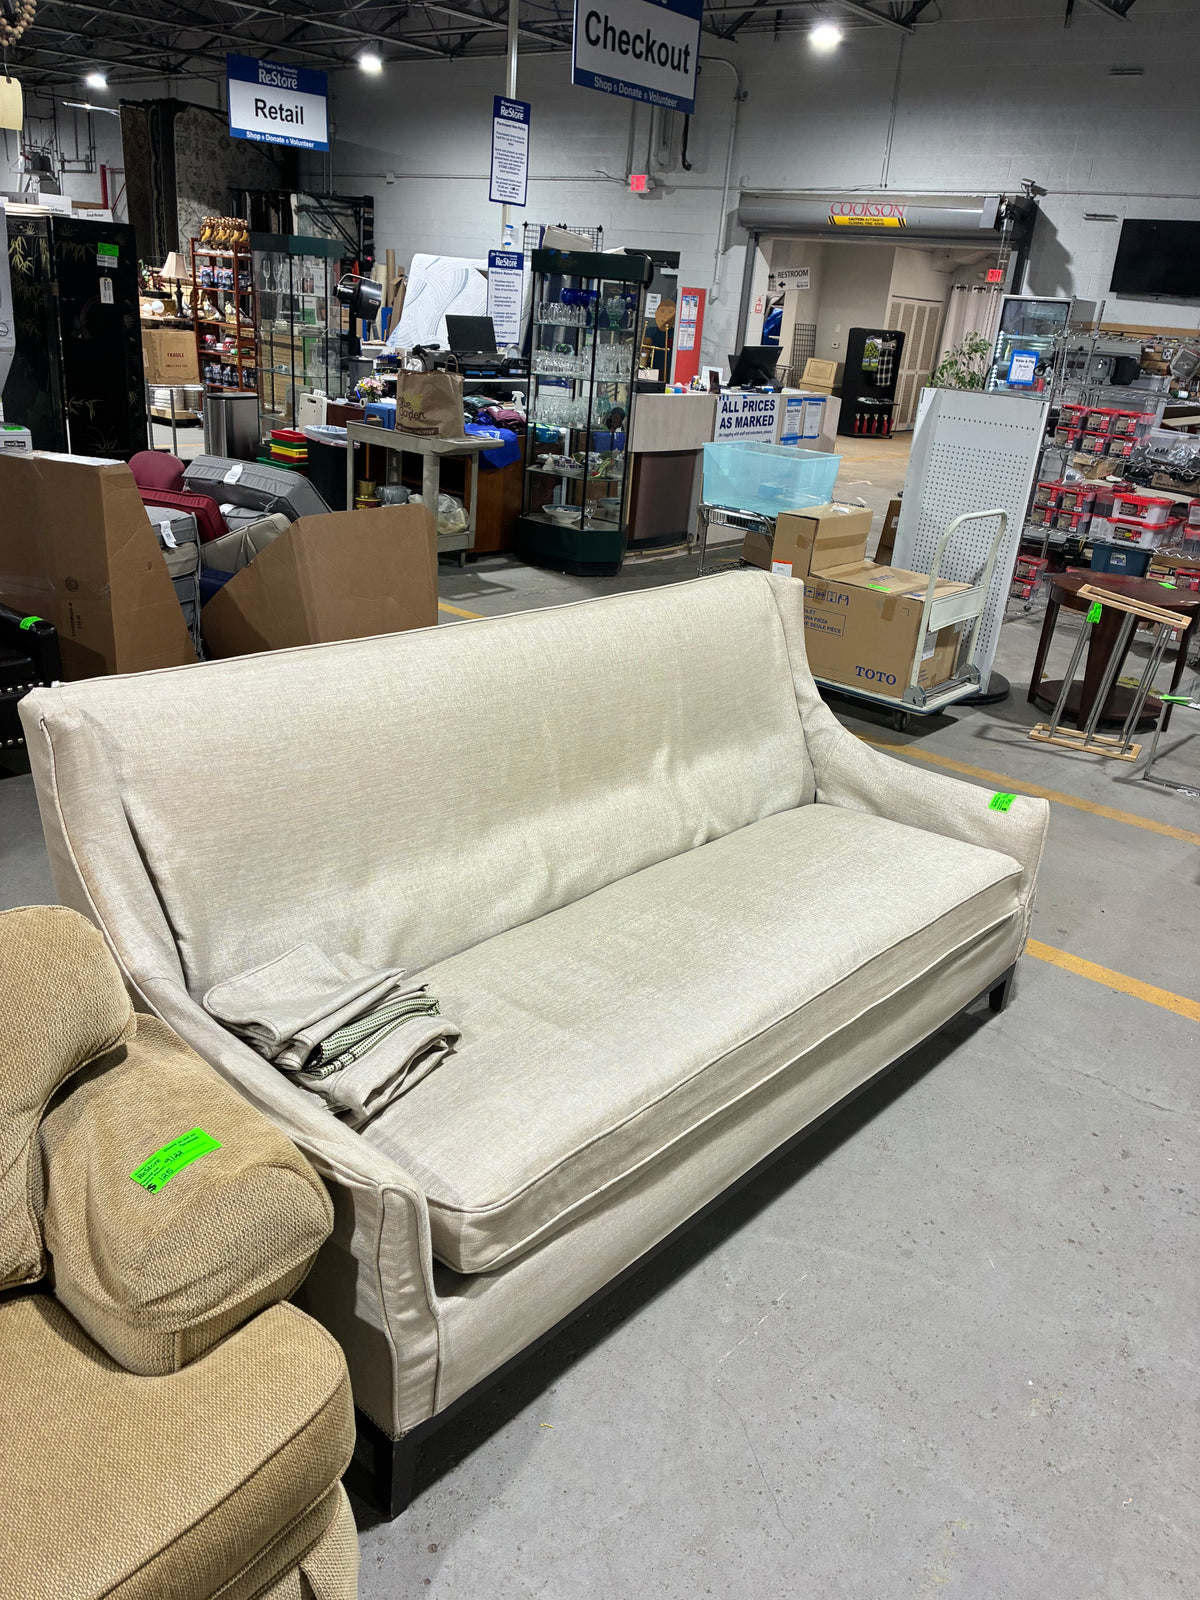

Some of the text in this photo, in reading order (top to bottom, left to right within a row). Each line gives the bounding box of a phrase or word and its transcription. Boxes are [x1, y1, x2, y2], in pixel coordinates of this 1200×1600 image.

[585, 10, 691, 74] Checkout
[258, 69, 298, 89] ReStore
[593, 76, 678, 108] Shop Donate Volunteer
[254, 98, 304, 125] Retail
[500, 105, 524, 120] ReStore
[246, 131, 315, 148] Shop Donate Volunteer
[830, 200, 906, 217] COOKSON
[495, 257, 518, 268] ReStore
[777, 269, 809, 279] RESTROOM
[721, 399, 776, 414] ALL PRICES
[719, 417, 733, 430] AS
[735, 414, 774, 429] MARKED
[855, 665, 897, 686] TOTO
